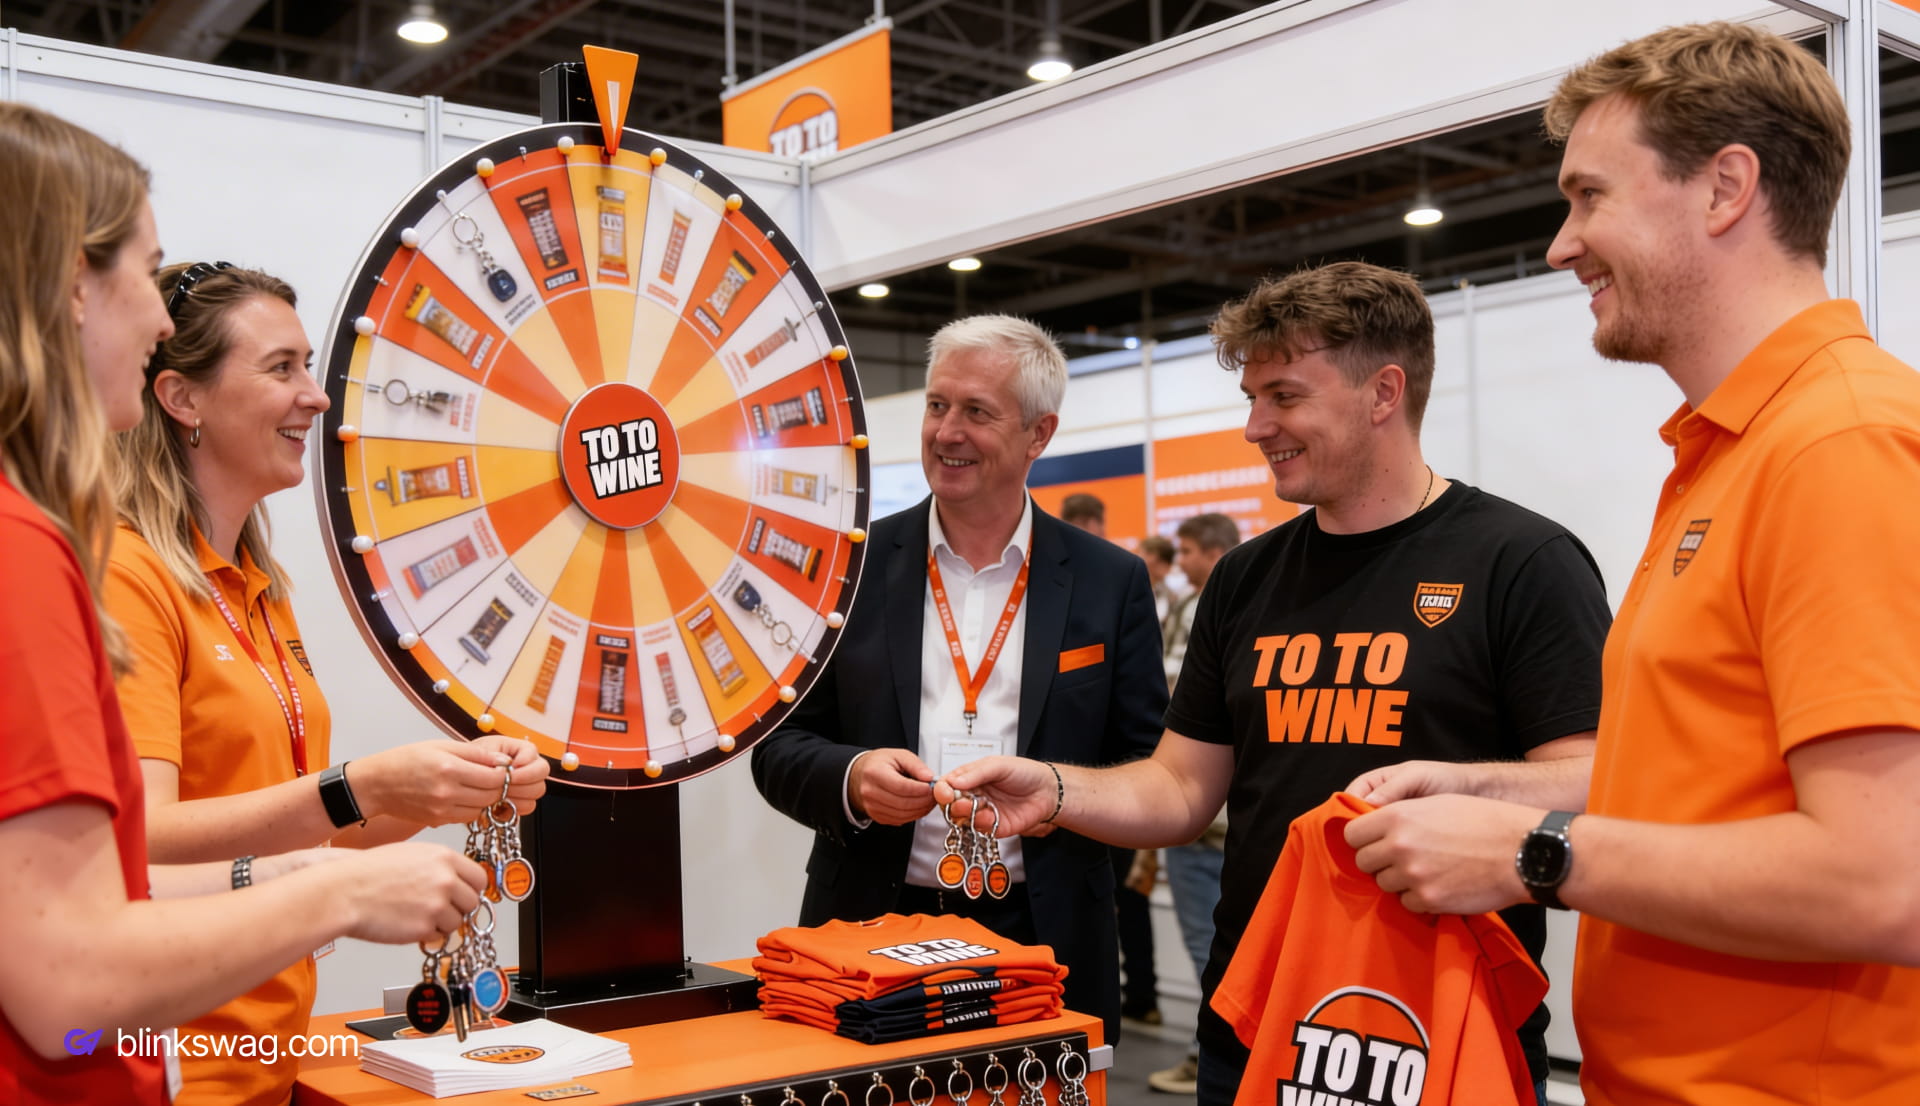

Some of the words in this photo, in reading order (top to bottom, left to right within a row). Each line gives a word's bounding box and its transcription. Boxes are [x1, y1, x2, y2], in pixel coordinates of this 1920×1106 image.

[802, 110, 838, 152] TO
[581, 426, 620, 464] TO
[621, 419, 658, 454] TO
[589, 451, 662, 497] WINE
[1252, 633, 1321, 687] TO
[1333, 631, 1409, 686] TO
[1265, 688, 1410, 747] WINE
[869, 943, 927, 959] TO
[917, 938, 969, 950] TO
[1295, 1025, 1362, 1093] TO
[1367, 1039, 1427, 1106] TO
